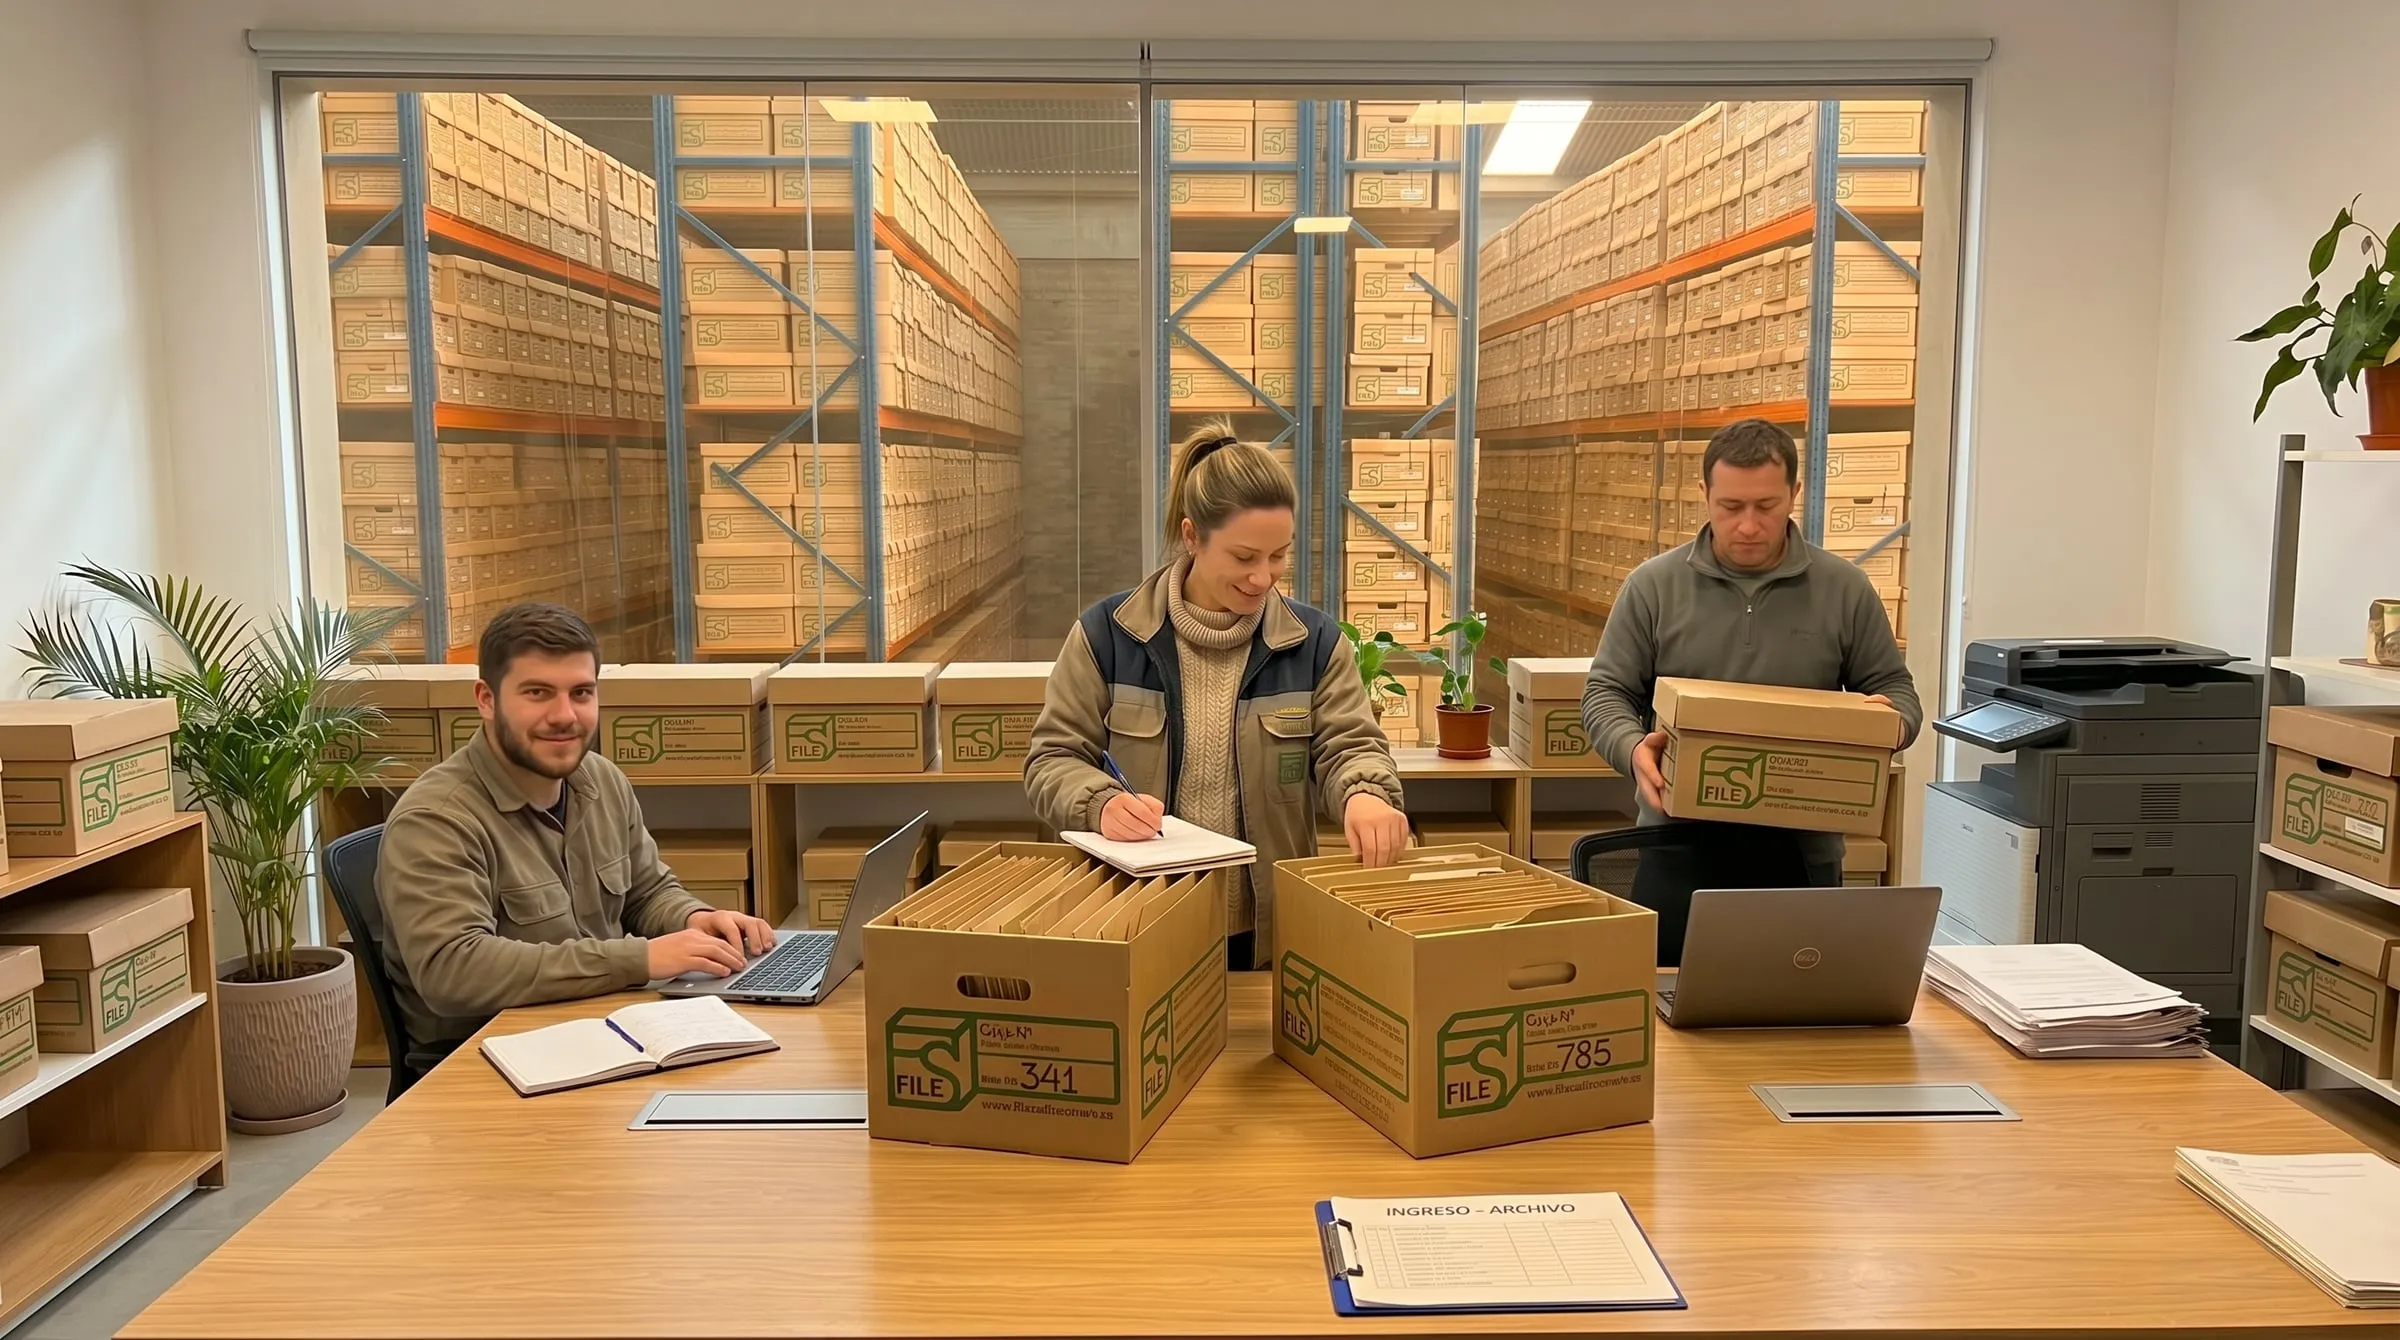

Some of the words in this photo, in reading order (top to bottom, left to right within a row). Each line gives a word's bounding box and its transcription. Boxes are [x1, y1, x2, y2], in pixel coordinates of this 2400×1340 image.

[618, 748, 648, 759] FILE
[791, 746, 821, 757] FILE
[958, 746, 988, 757] FILE
[1550, 740, 1579, 751] FILE
[1704, 786, 1742, 802] FILE
[86, 804, 109, 824] FILE
[2286, 815, 2309, 835] FILE
[2279, 990, 2300, 1013] FILE
[106, 1004, 125, 1025] FILE
[1285, 1009, 1307, 1041] FILE
[1556, 1038, 1612, 1072] 785
[896, 1074, 944, 1098] FILE
[1020, 1062, 1078, 1094] 341
[1145, 1067, 1164, 1103] FILE
[1446, 1079, 1492, 1105] FILE
[1386, 1206, 1470, 1217] INGRESO
[1489, 1203, 1576, 1215] ARCHIVO
